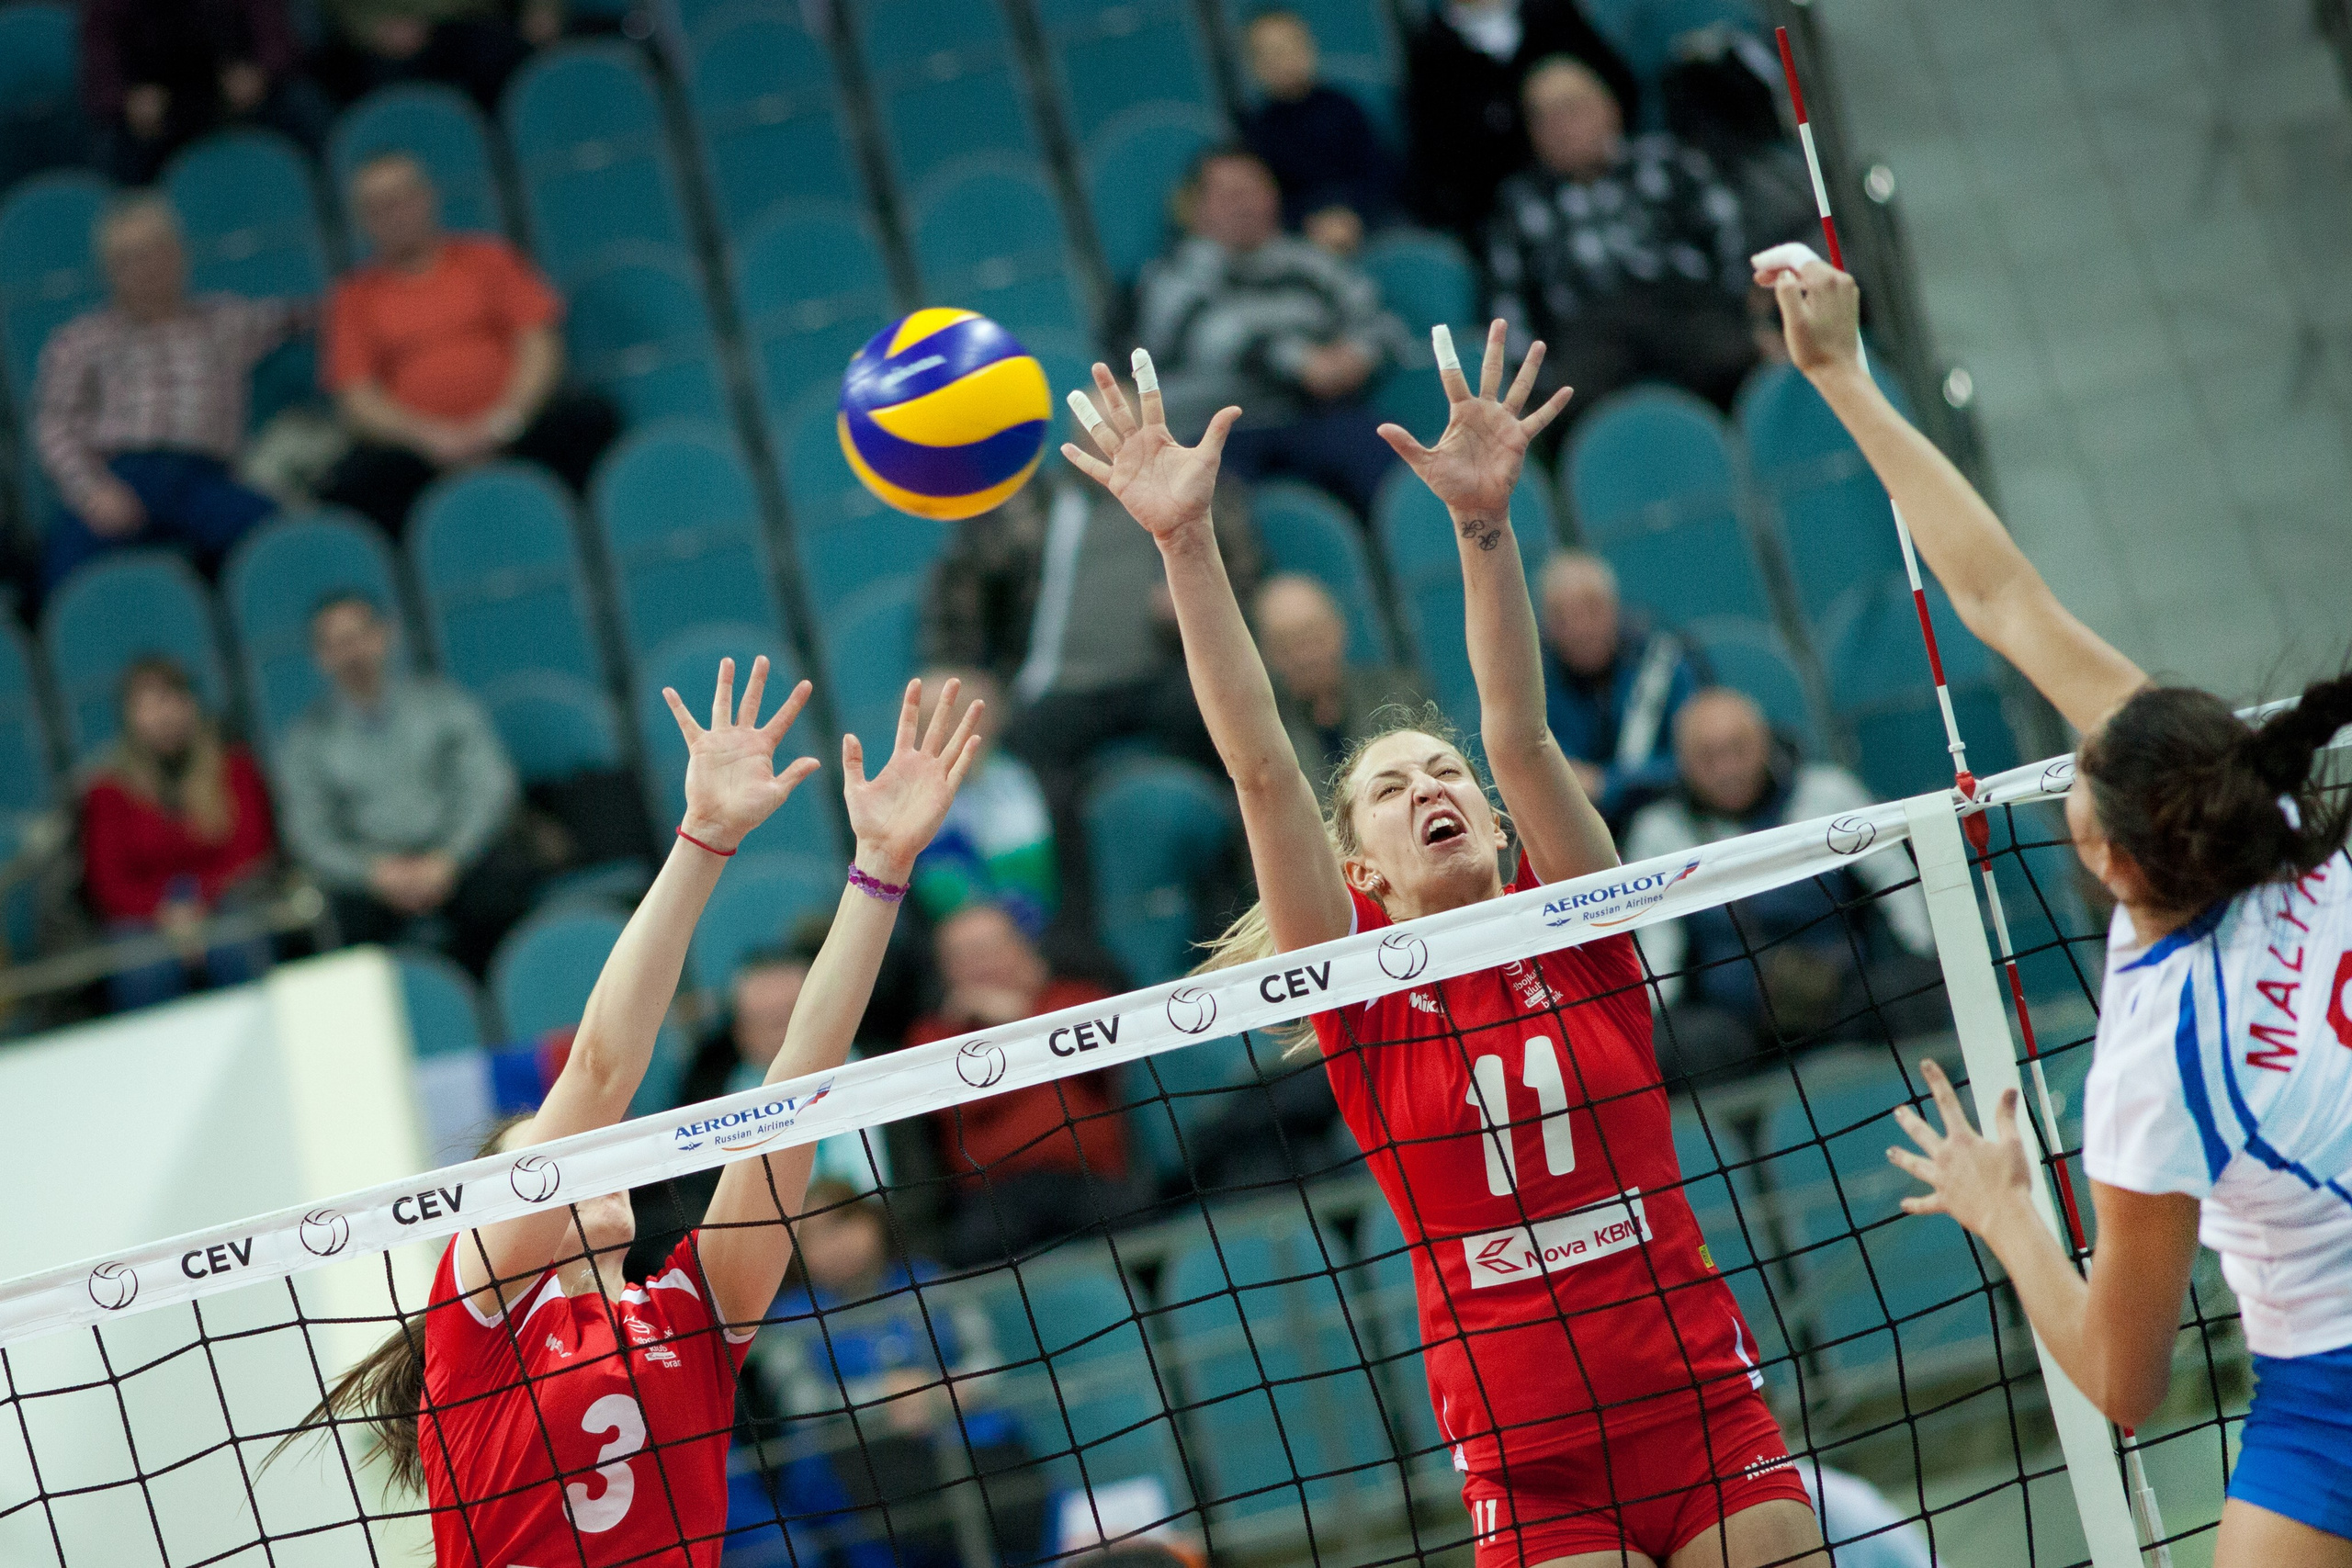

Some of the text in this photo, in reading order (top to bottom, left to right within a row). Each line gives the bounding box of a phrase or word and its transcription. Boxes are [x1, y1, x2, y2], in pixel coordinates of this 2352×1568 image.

[1543, 872, 1666, 917] AEROFLOT
[1583, 893, 1664, 921] Russian Airlines
[1260, 961, 1330, 1003] CEV
[1048, 1015, 1120, 1056] CEV
[675, 1097, 797, 1140] AEROFLOT
[714, 1118, 795, 1145] Russian Airlines
[1465, 1034, 1577, 1196] 11
[393, 1184, 462, 1225] CEV
[182, 1237, 252, 1280] CEV
[1524, 1215, 1643, 1269] Nova KBM
[562, 1393, 646, 1533] 3
